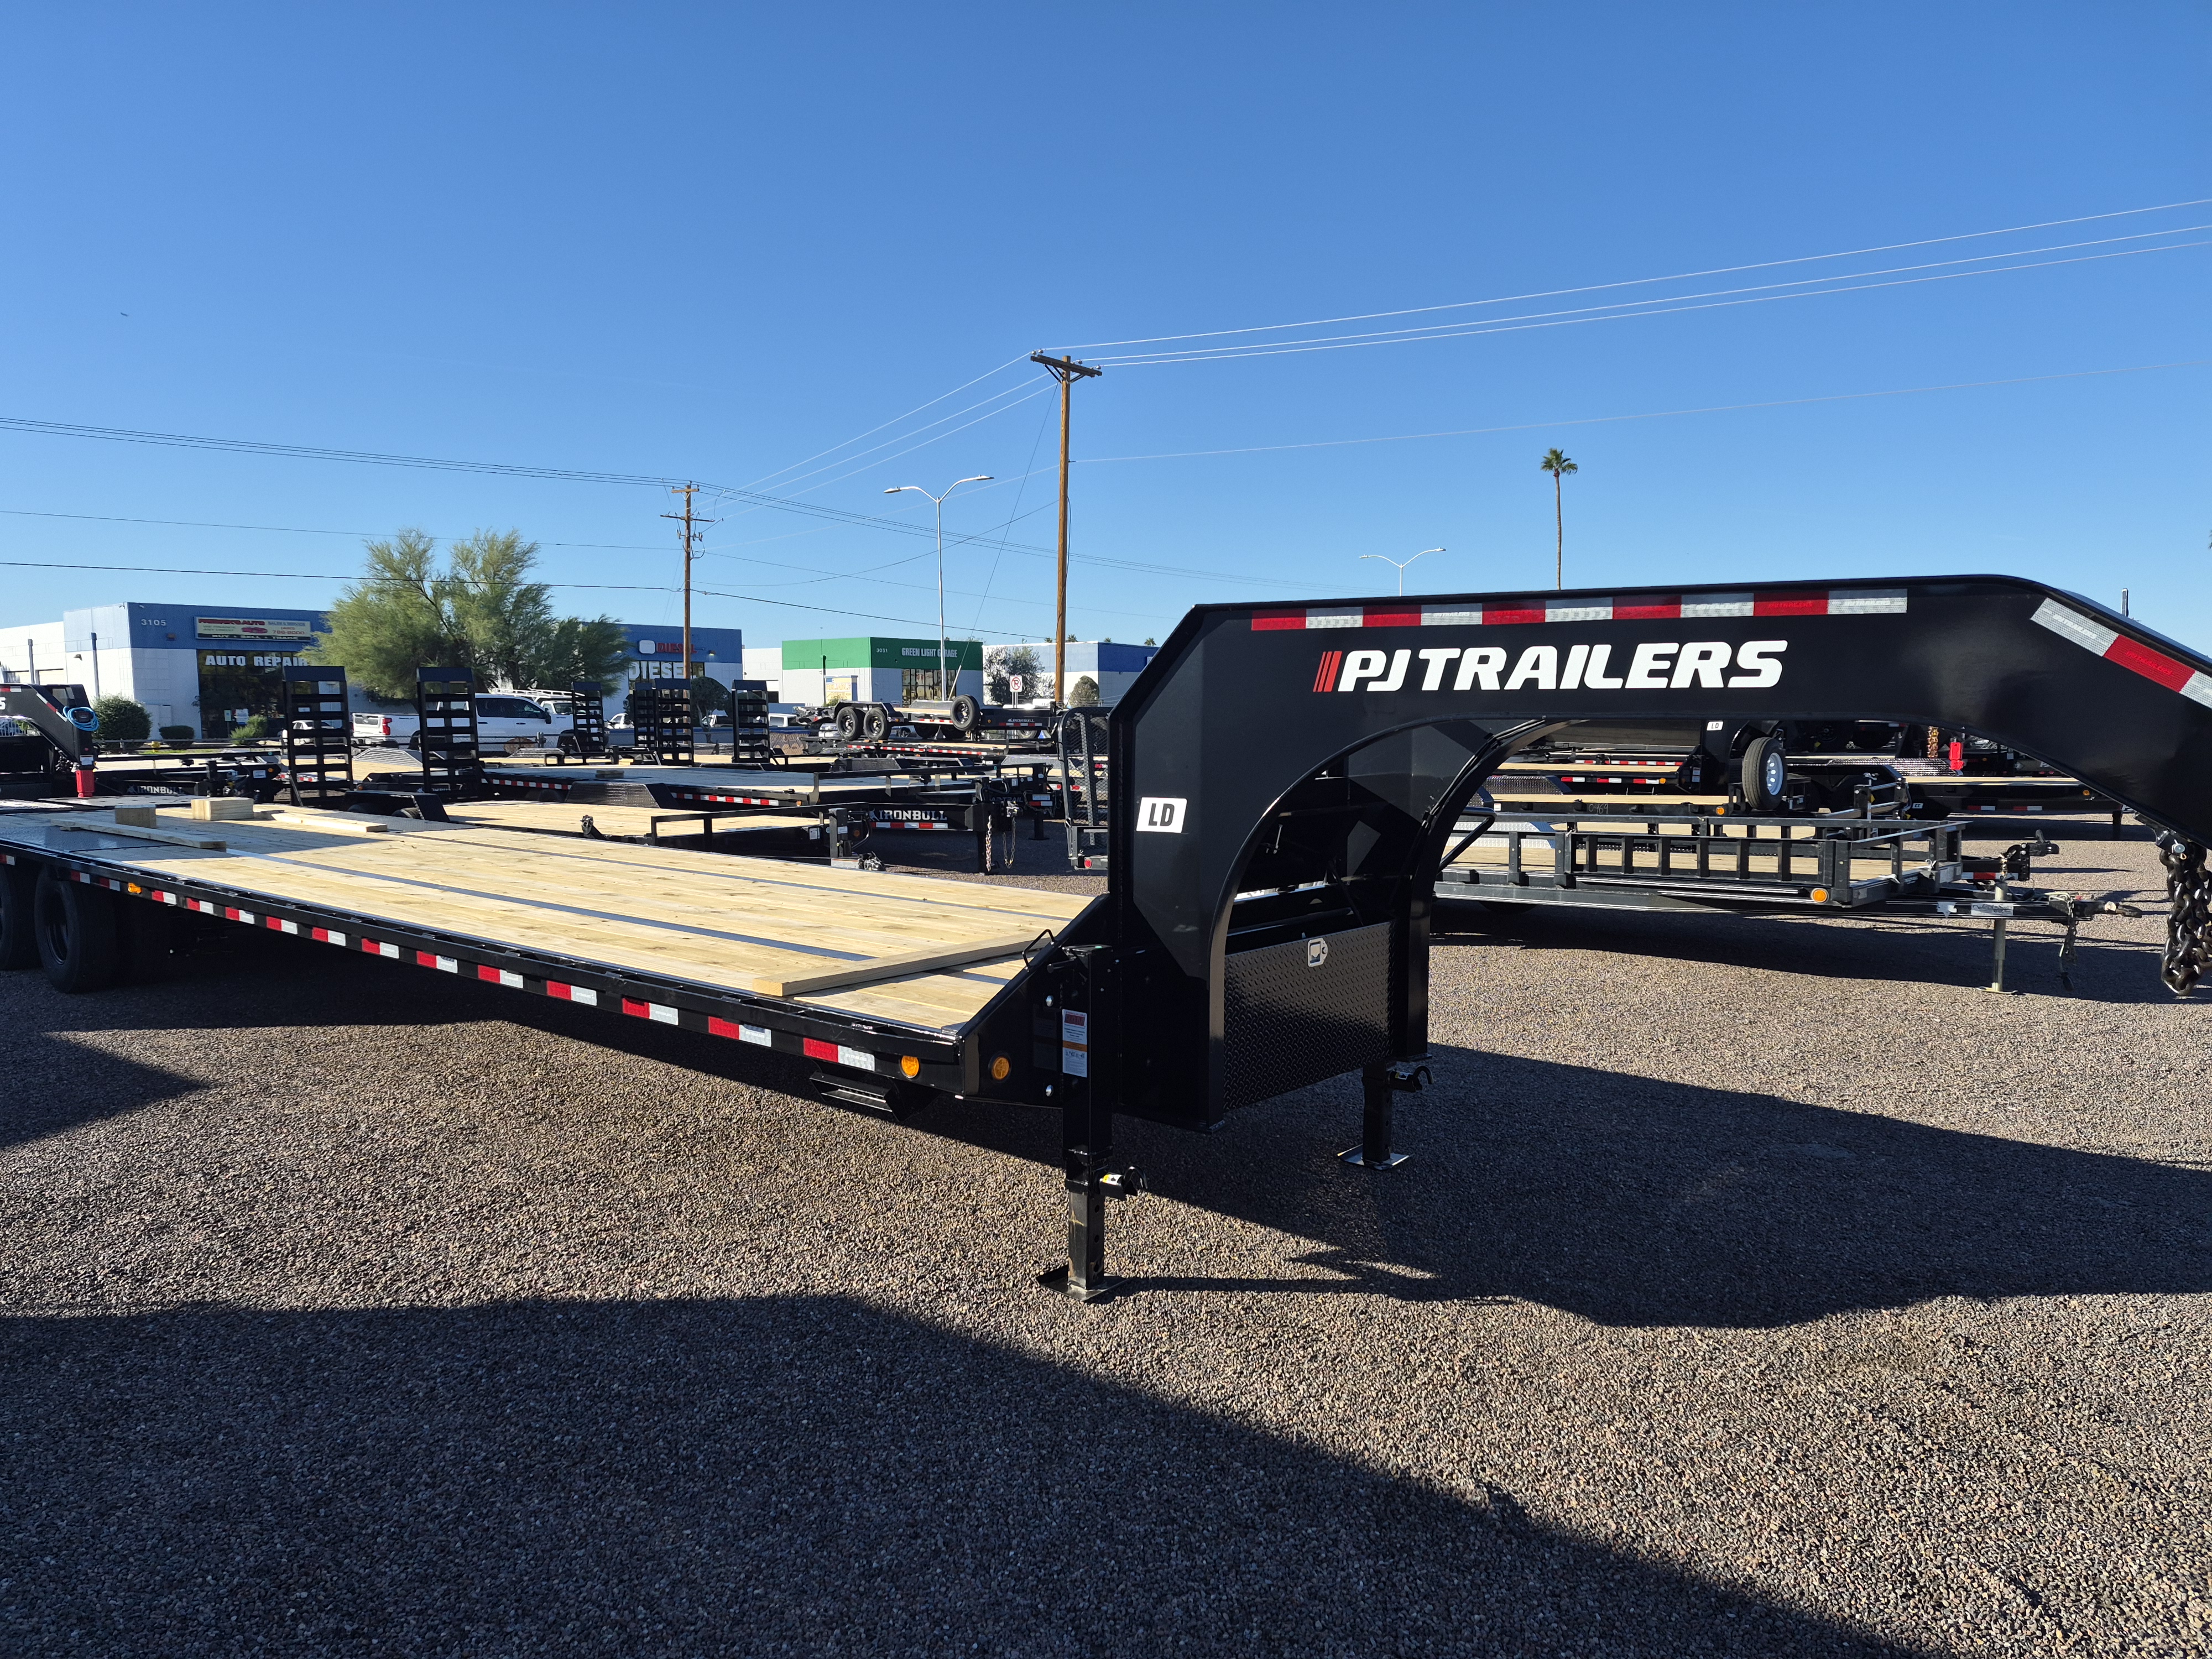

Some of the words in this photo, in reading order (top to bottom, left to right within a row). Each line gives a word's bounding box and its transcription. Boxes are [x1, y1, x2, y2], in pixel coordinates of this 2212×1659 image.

[656, 643, 697, 653] DIESL
[901, 648, 920, 656] GREEN
[921, 648, 936, 657] LIGHT
[937, 649, 957, 658] GRAGE
[205, 655, 246, 666] AUTO
[253, 656, 308, 666] REPAIR
[1338, 649, 1412, 692] PJ
[1418, 640, 1788, 691] TRAILERS
[879, 810, 947, 821] IRONBULL
[1148, 803, 1175, 826] LD
